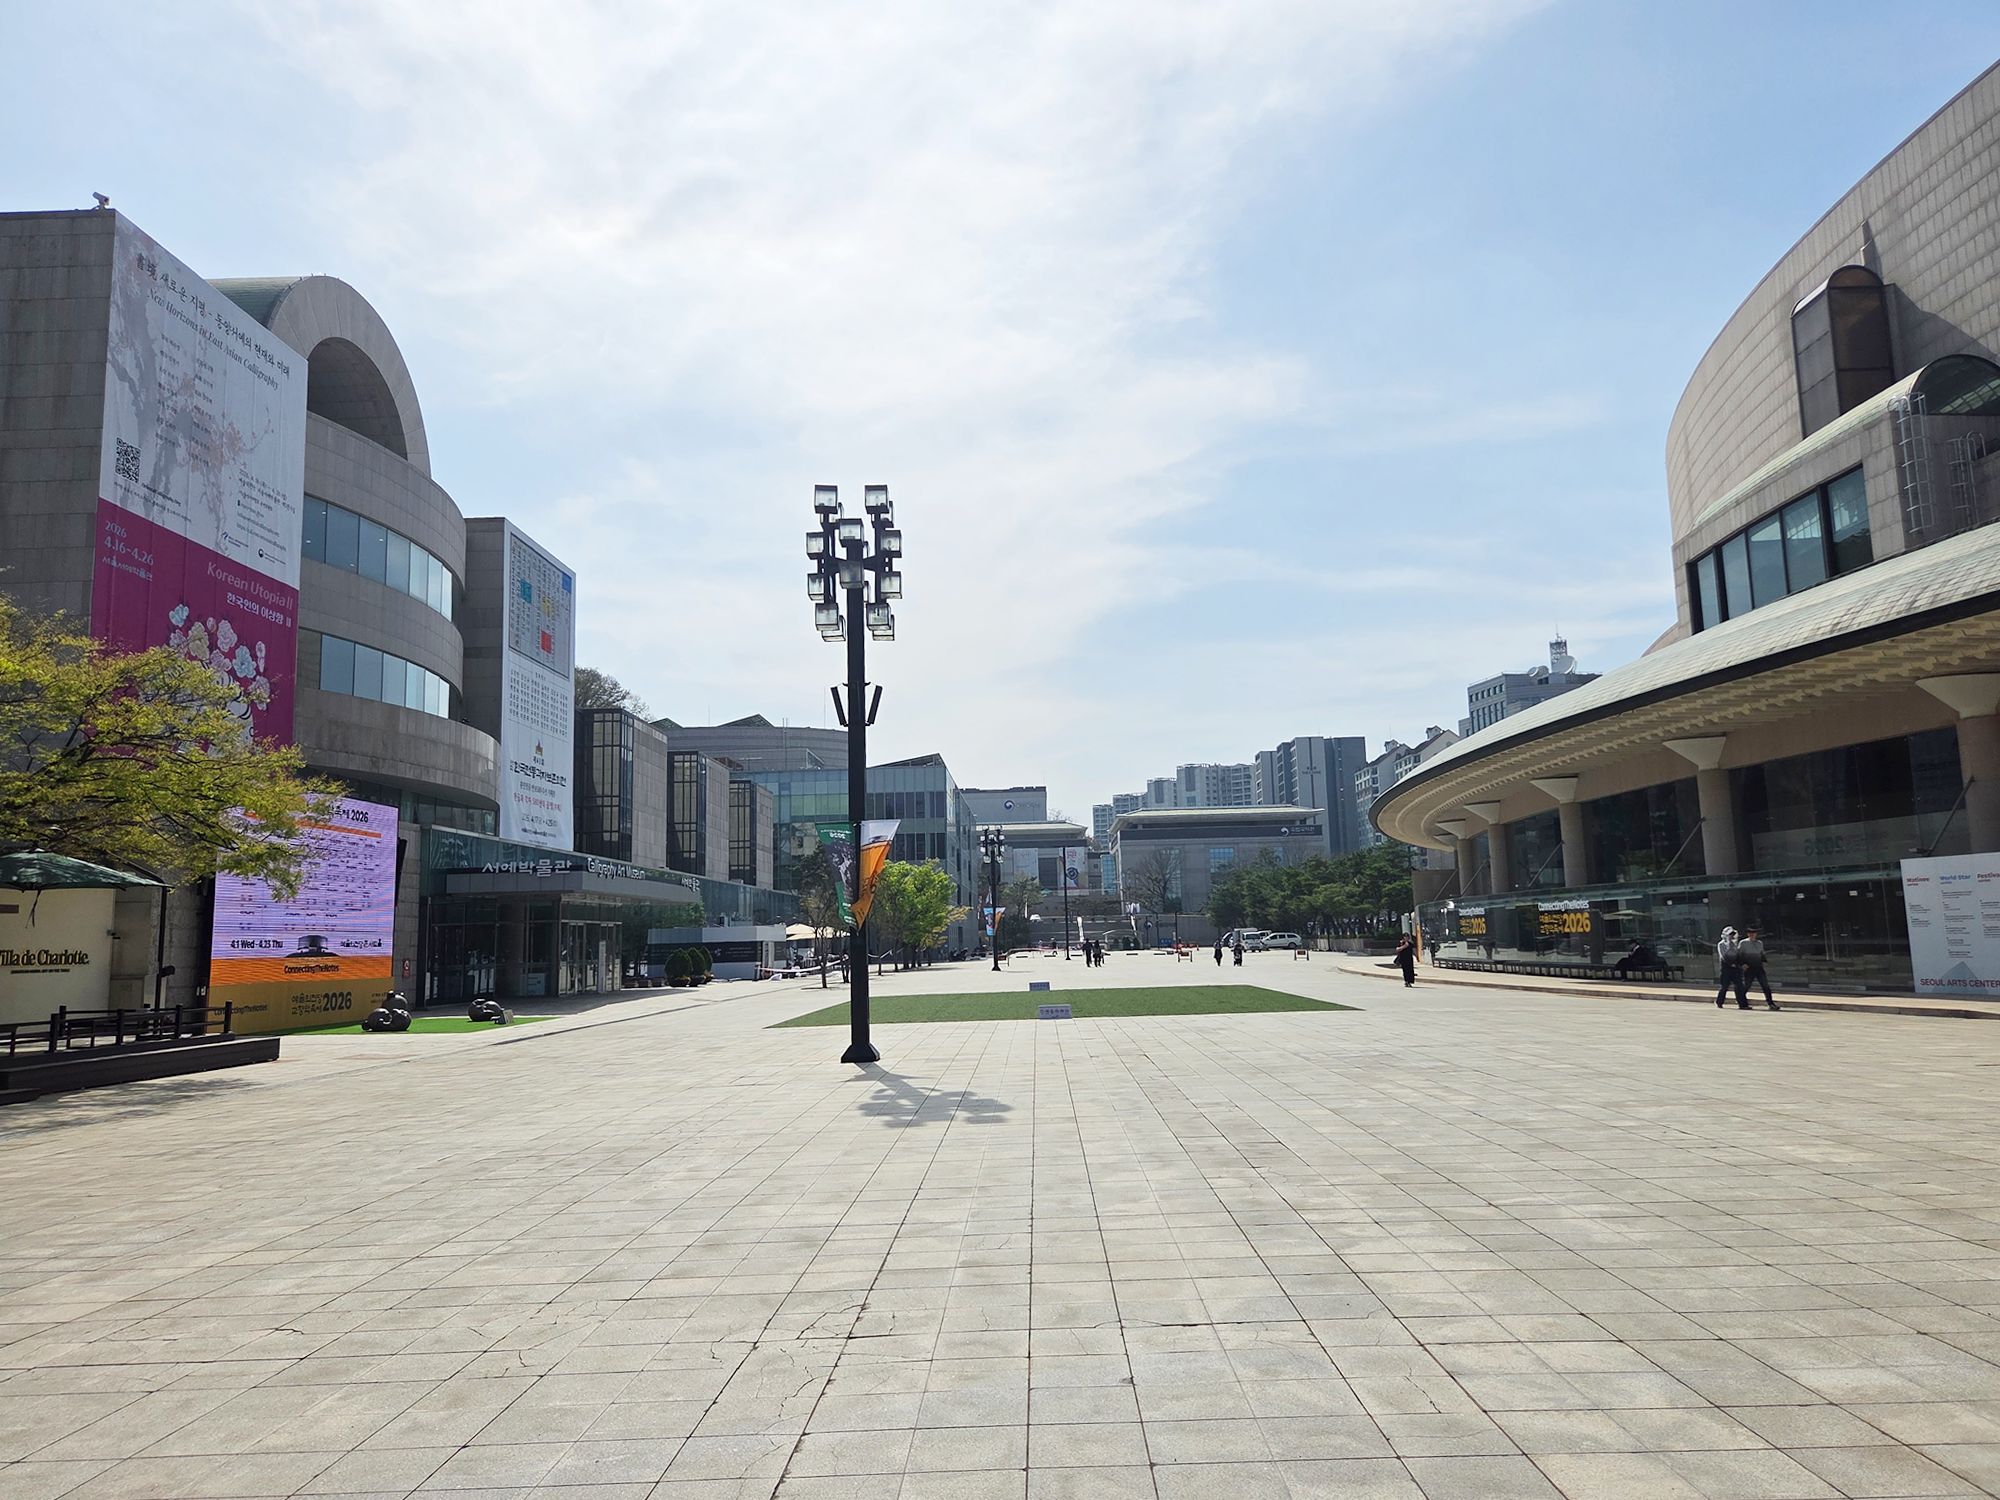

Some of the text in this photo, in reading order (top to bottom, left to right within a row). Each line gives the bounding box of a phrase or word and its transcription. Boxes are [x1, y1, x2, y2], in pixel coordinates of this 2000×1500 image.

[147, 288, 278, 391] New Horizons in East Asian Calligraphy
[277, 361, 290, 380] 미래
[104, 520, 127, 538] 2026
[207, 562, 248, 591] Korean
[250, 581, 286, 606] Utopia
[226, 592, 259, 615] 한국인의
[261, 606, 284, 624] 이상향
[351, 809, 369, 823] 2026
[482, 859, 572, 876] 서예박물관
[587, 857, 646, 880] Calligraphy Art Museum
[1472, 918, 1486, 934] 2026
[1563, 912, 1591, 932] 2026
[240, 940, 254, 948] Wed
[272, 940, 283, 948] Thu
[21, 949, 36, 966] de
[284, 964, 339, 974] ConnectingTheNotes
[1920, 978, 2000, 988] SEOUL ARTS CENTER
[322, 991, 352, 1012] 2026
